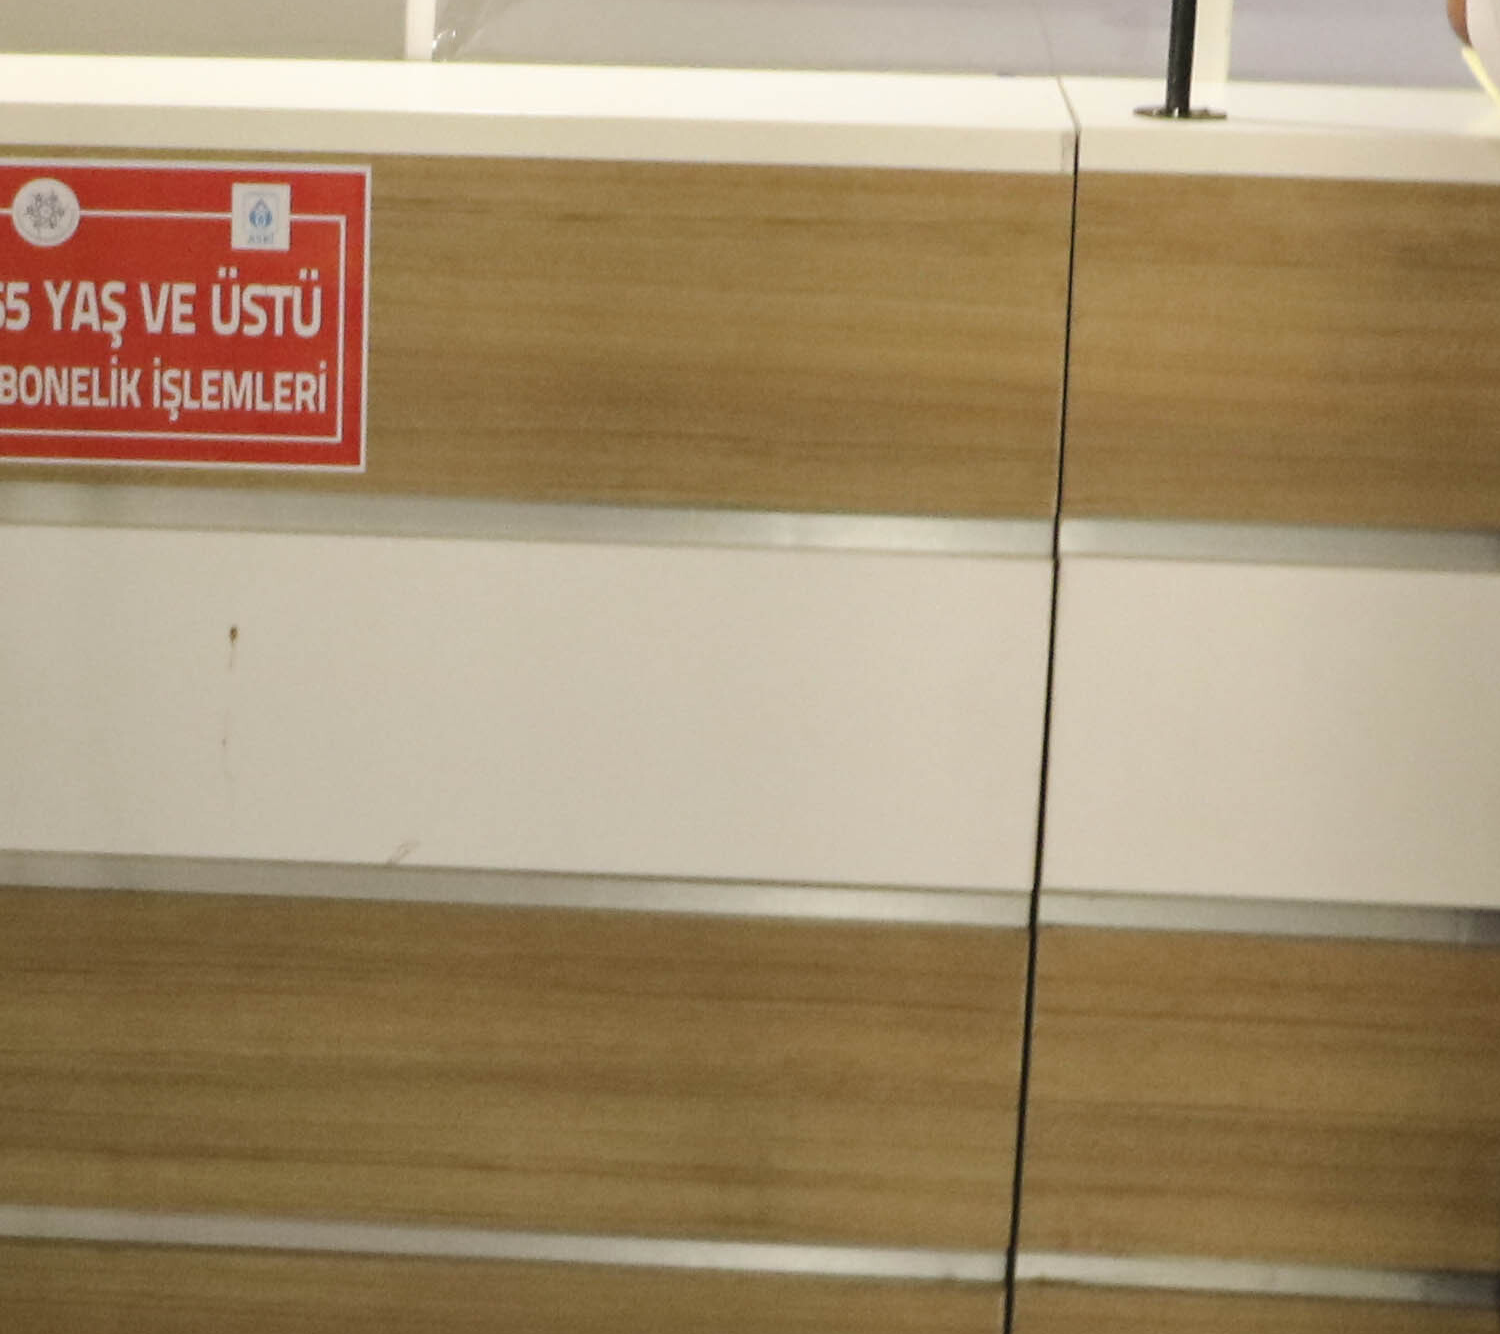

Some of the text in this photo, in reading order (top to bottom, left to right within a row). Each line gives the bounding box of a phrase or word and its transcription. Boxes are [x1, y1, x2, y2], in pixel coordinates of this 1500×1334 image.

[43, 279, 127, 349] YAŞ
[139, 282, 197, 335] VE
[211, 266, 323, 338] ÜSTÜ
[151, 356, 327, 422] İŞLEMLERİ
